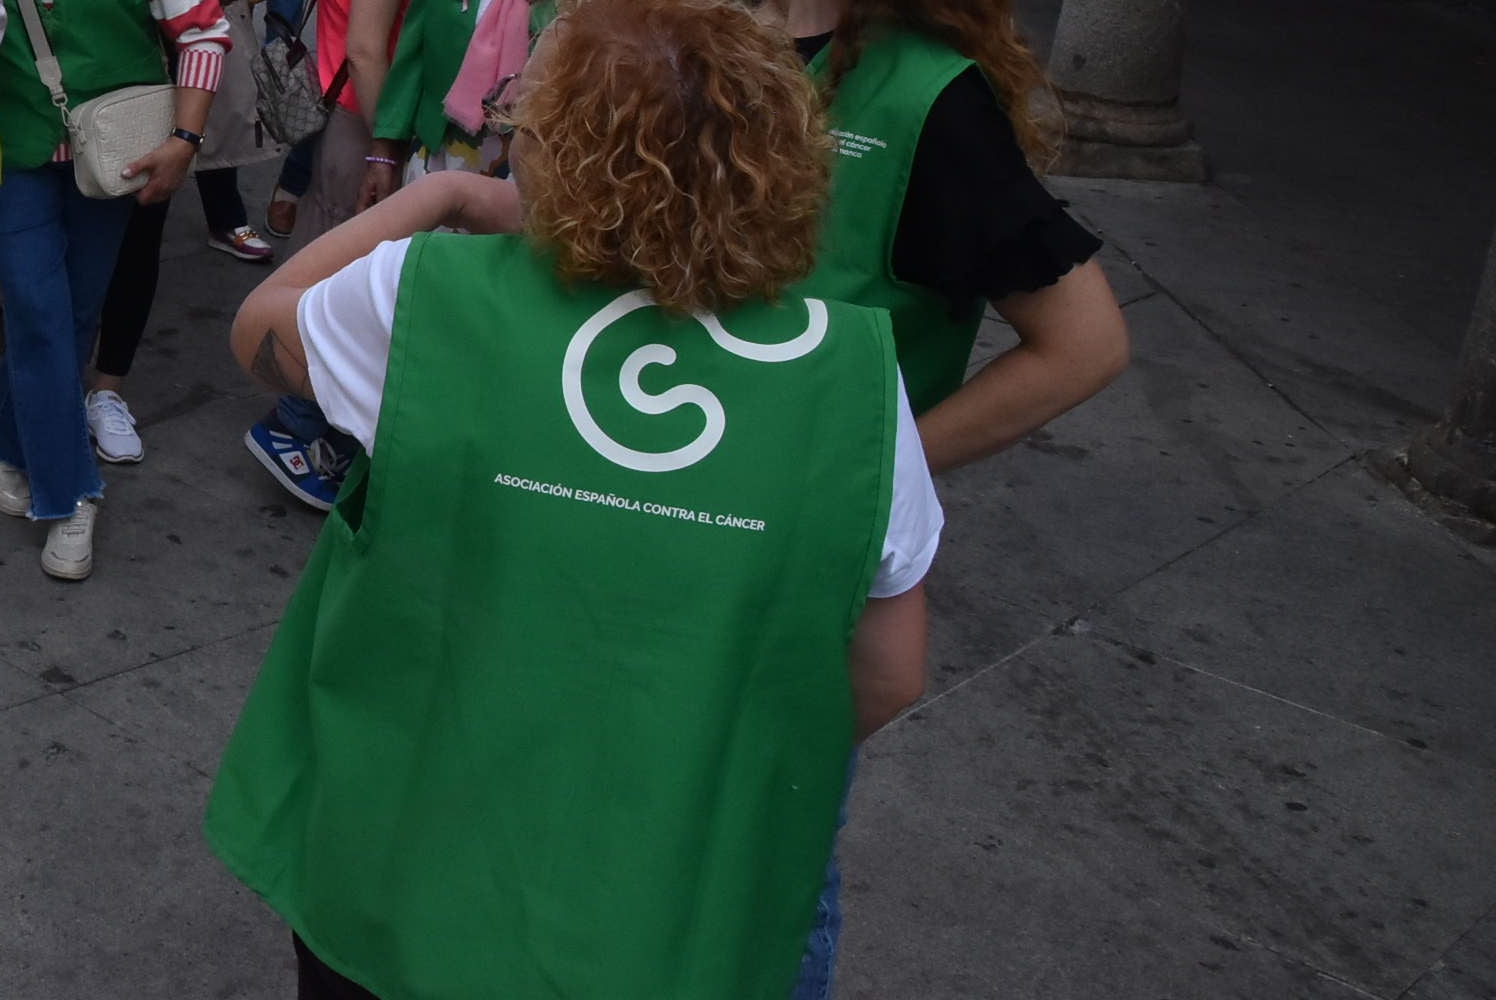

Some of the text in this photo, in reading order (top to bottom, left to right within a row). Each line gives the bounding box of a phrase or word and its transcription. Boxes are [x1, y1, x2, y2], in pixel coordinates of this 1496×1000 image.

[494, 473, 766, 532] ASOCIACIÓN ESPAÑOLA CONTRA EL CÁNCER
